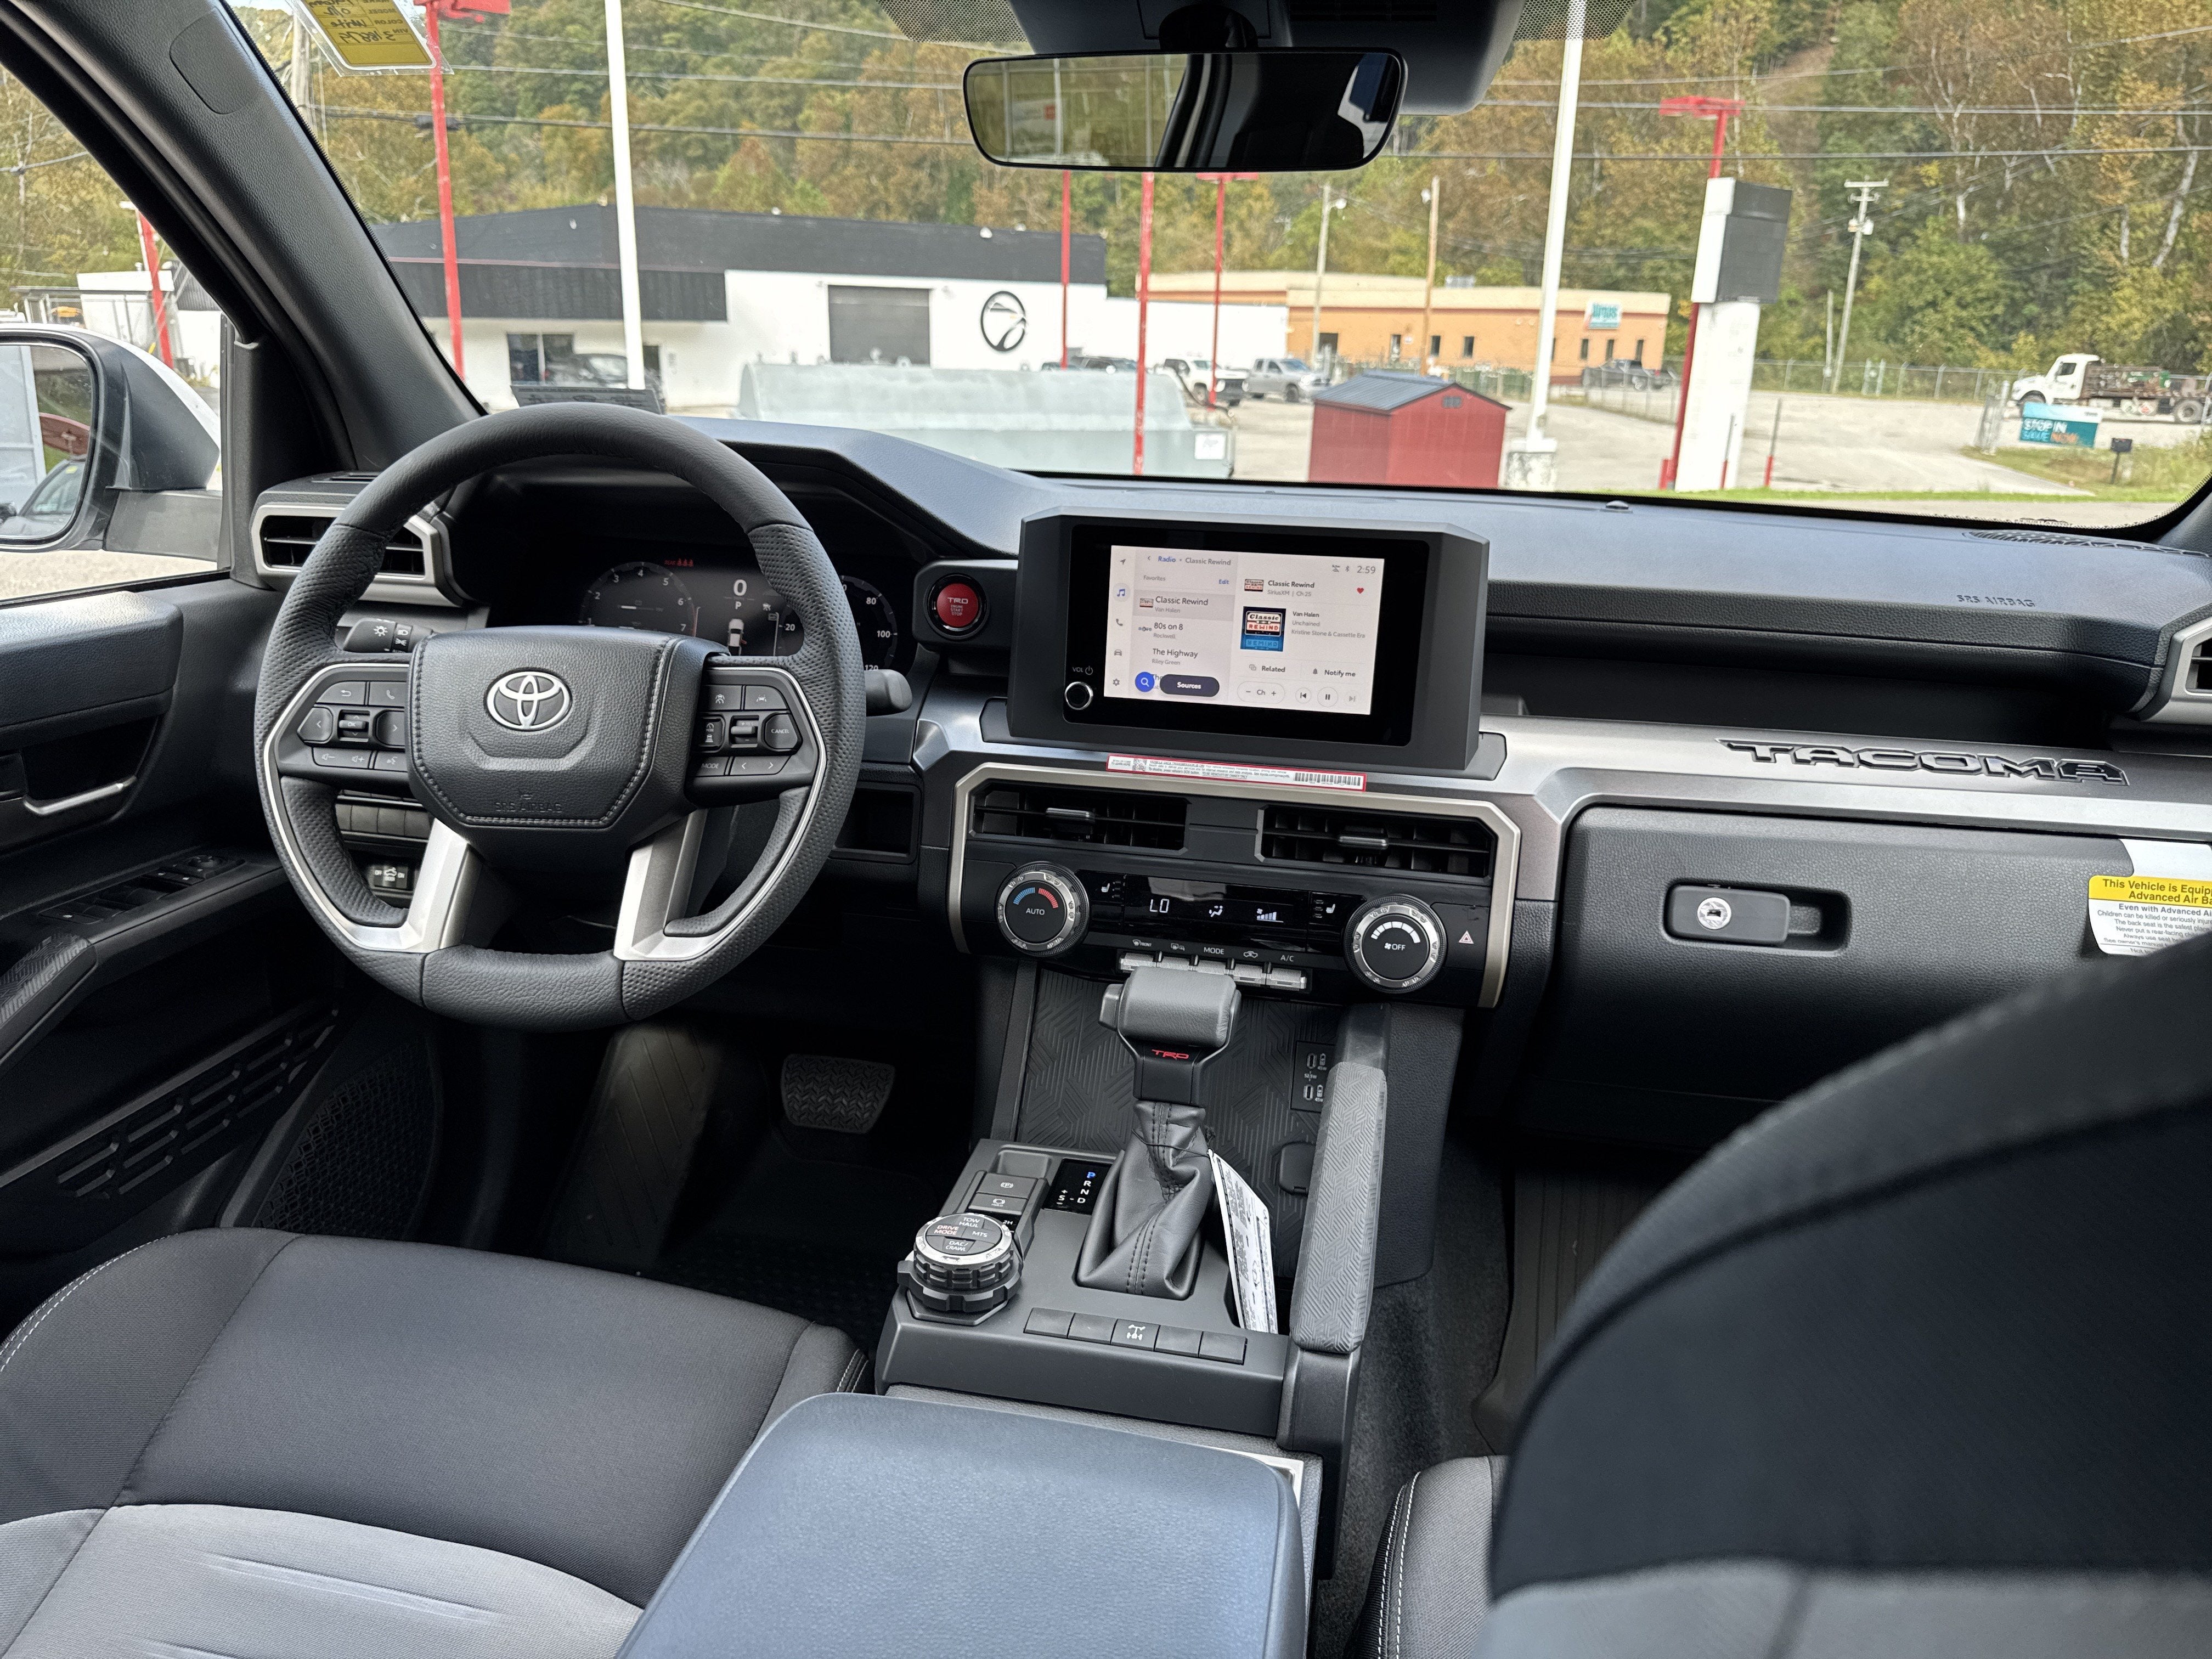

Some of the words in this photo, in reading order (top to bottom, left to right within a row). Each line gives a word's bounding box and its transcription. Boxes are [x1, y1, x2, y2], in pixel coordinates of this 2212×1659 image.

[2053, 421, 2068, 433] IN
[733, 579, 747, 596] 0
[735, 601, 742, 610] P
[1155, 596, 1180, 604] Classic
[1956, 595, 1980, 603] SRS
[1985, 596, 2035, 607] AIRBAG
[1167, 650, 1198, 659] Highway
[1714, 737, 2130, 787] TACOMA
[2103, 878, 2125, 888] This
[2128, 880, 2166, 891] Vehicle
[2168, 883, 2177, 892] is
[2181, 884, 2212, 897] Equip
[2129, 891, 2181, 903] Advanced
[2183, 895, 2198, 904] Air
[1149, 899, 1170, 913] LO
[2119, 903, 2139, 911] Even
[2160, 907, 2201, 916] Advanced
[2170, 916, 2196, 924] seriously
[1204, 947, 1224, 955] MODE
[1151, 1049, 1189, 1059] TRD
